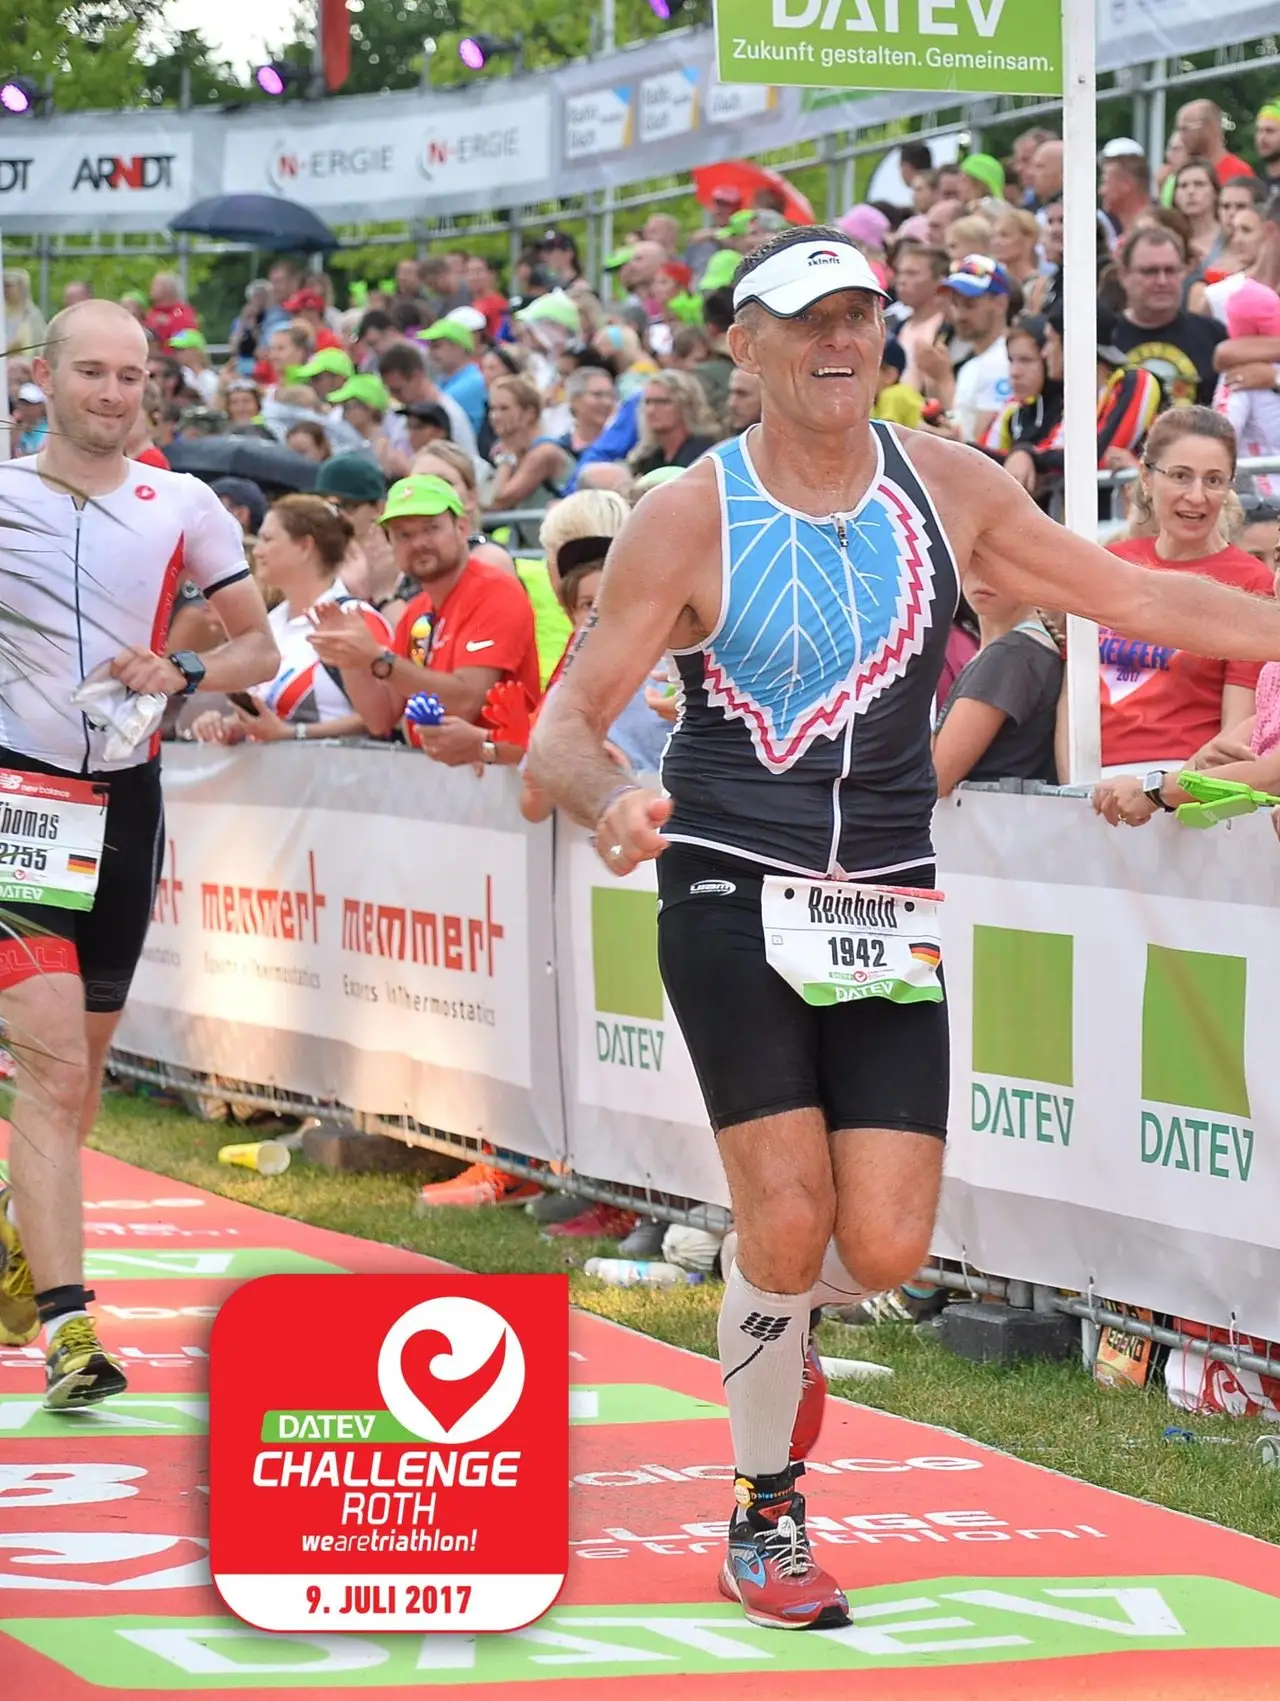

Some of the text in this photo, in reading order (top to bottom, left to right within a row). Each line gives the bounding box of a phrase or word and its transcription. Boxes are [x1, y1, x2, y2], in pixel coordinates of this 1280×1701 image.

[732, 38, 1054, 72] Zukunft gestalten. Gemeinsam.
[72, 154, 176, 190] ARNDT
[0, 800, 60, 840] homas
[808, 886, 898, 929] Reinhold
[828, 936, 888, 968] 1942
[835, 980, 894, 1002] DATEV
[595, 1020, 664, 1072] DATEV
[971, 1083, 1074, 1146] DATEV
[1140, 1110, 1254, 1182] DATEV
